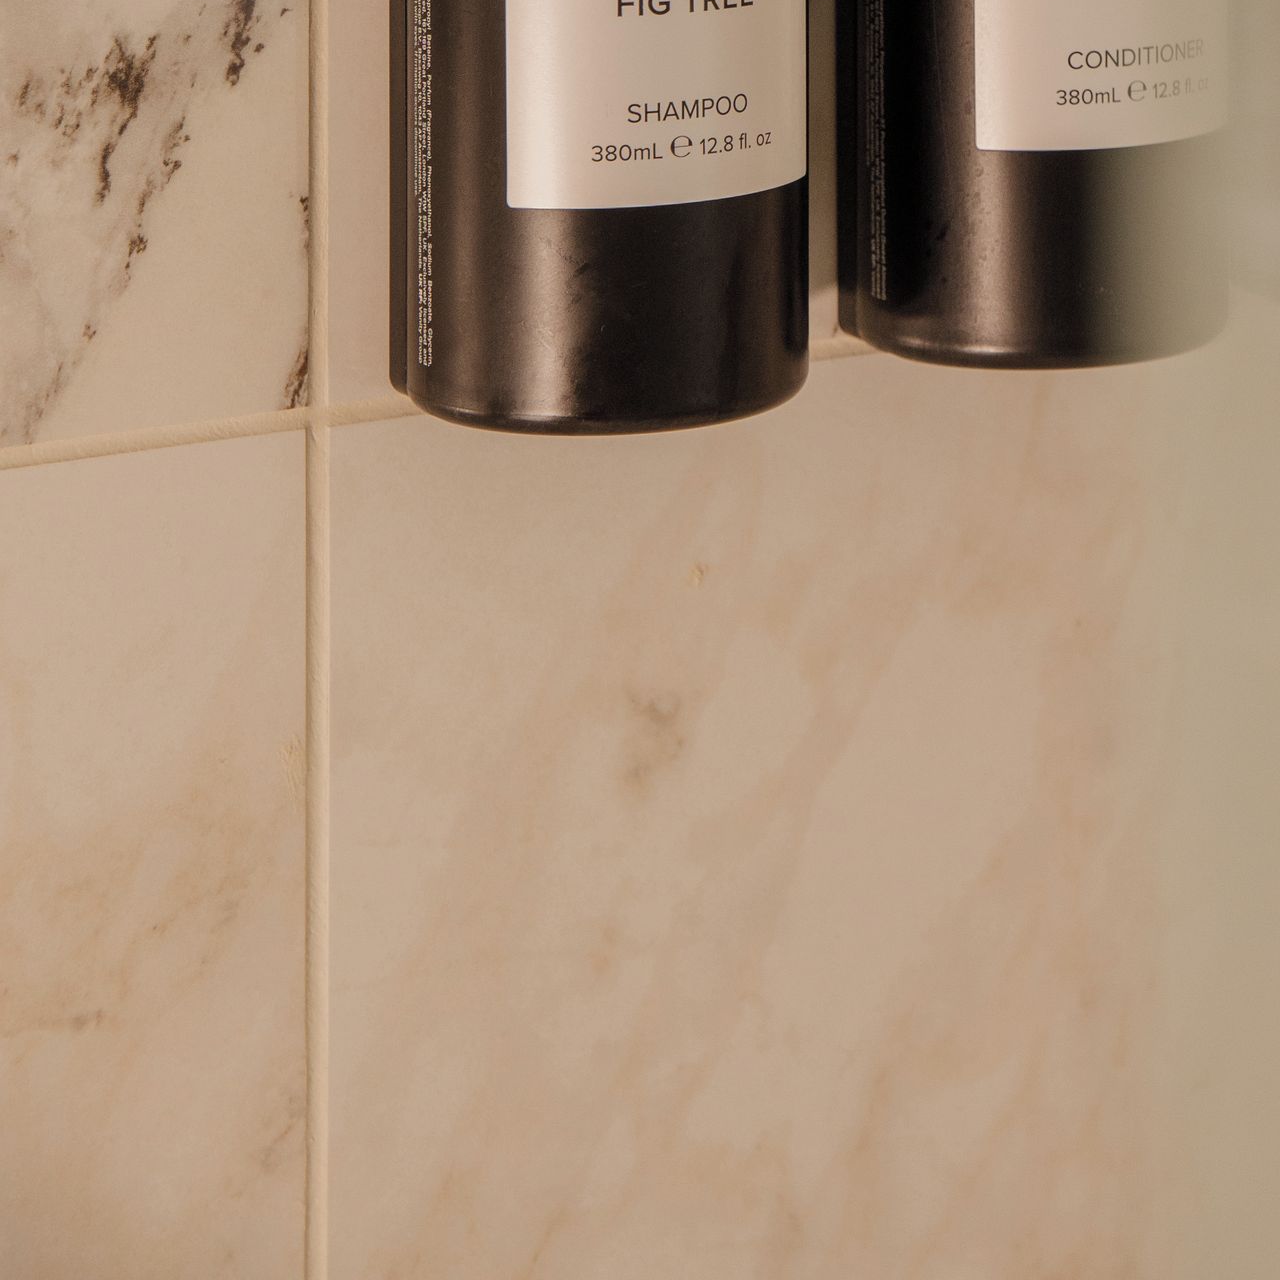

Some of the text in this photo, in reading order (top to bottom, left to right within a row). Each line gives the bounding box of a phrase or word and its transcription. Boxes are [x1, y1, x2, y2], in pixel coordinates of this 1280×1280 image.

[1067, 39, 1204, 70] CONDITIONER
[627, 92, 749, 124] SHAMPOO
[1055, 87, 1121, 107] 380mL
[1153, 79, 1180, 100] 12.8
[590, 144, 663, 163] 380mL
[699, 135, 734, 156] 12.8
[739, 130, 752, 151] fl.
[756, 130, 772, 148] oz
